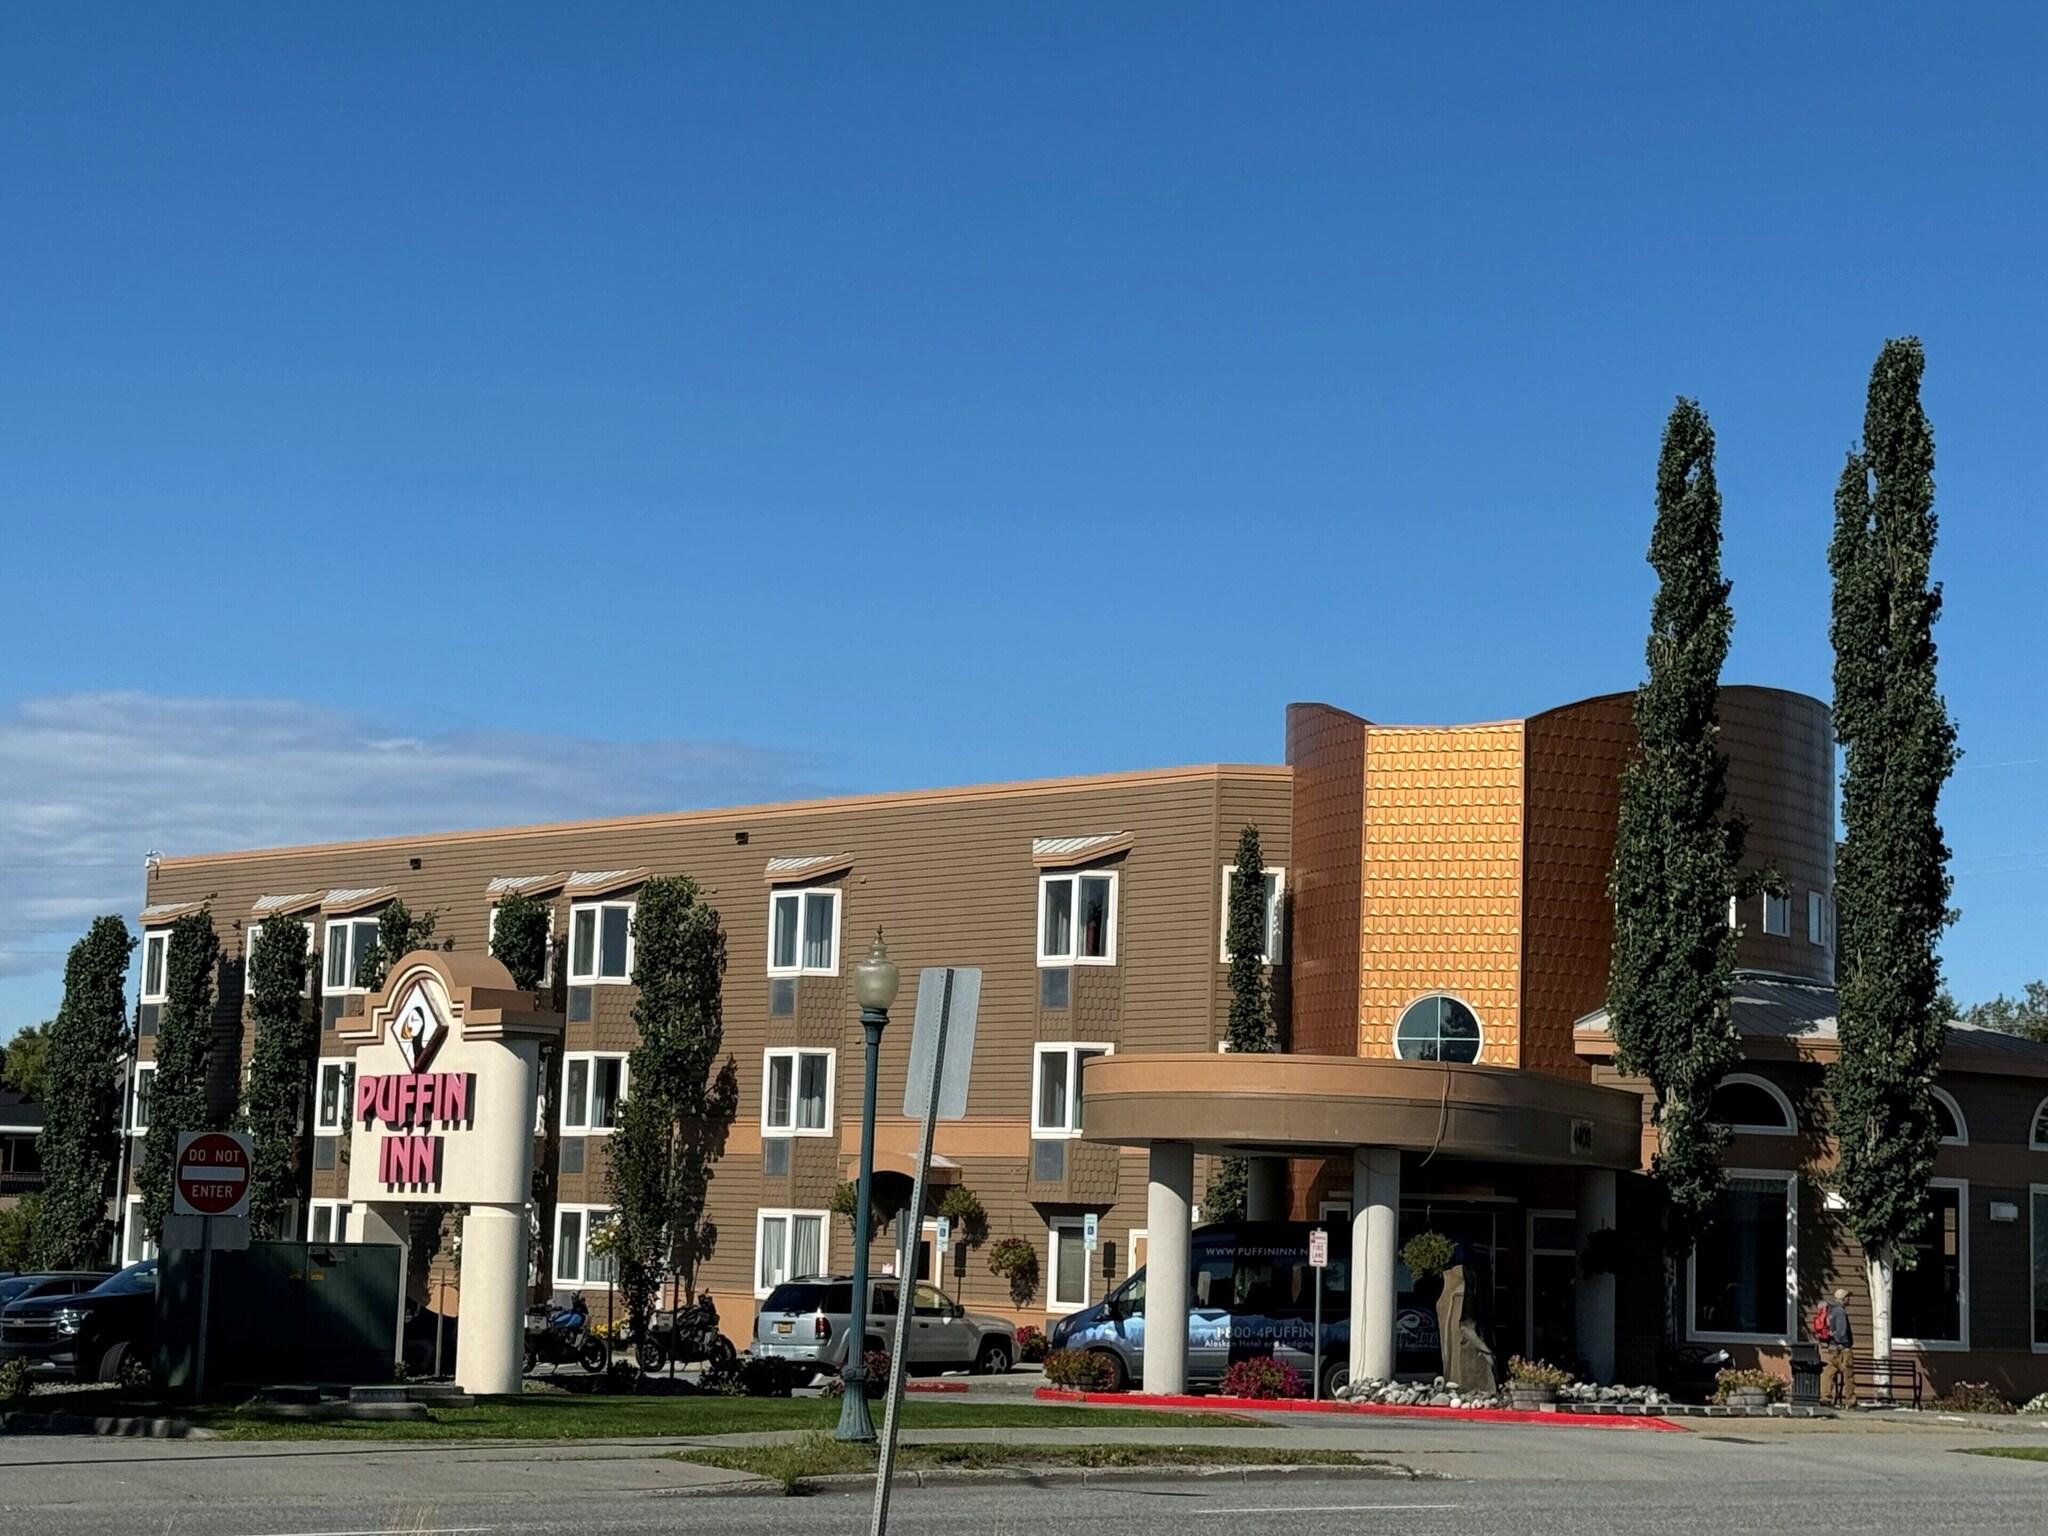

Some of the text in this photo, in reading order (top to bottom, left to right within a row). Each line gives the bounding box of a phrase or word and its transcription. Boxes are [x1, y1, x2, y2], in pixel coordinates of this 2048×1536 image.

[357, 1072, 468, 1128] PUFFIN
[189, 1148, 240, 1163] DO NOT
[378, 1135, 435, 1184] INN
[191, 1184, 233, 1198] ENTER
